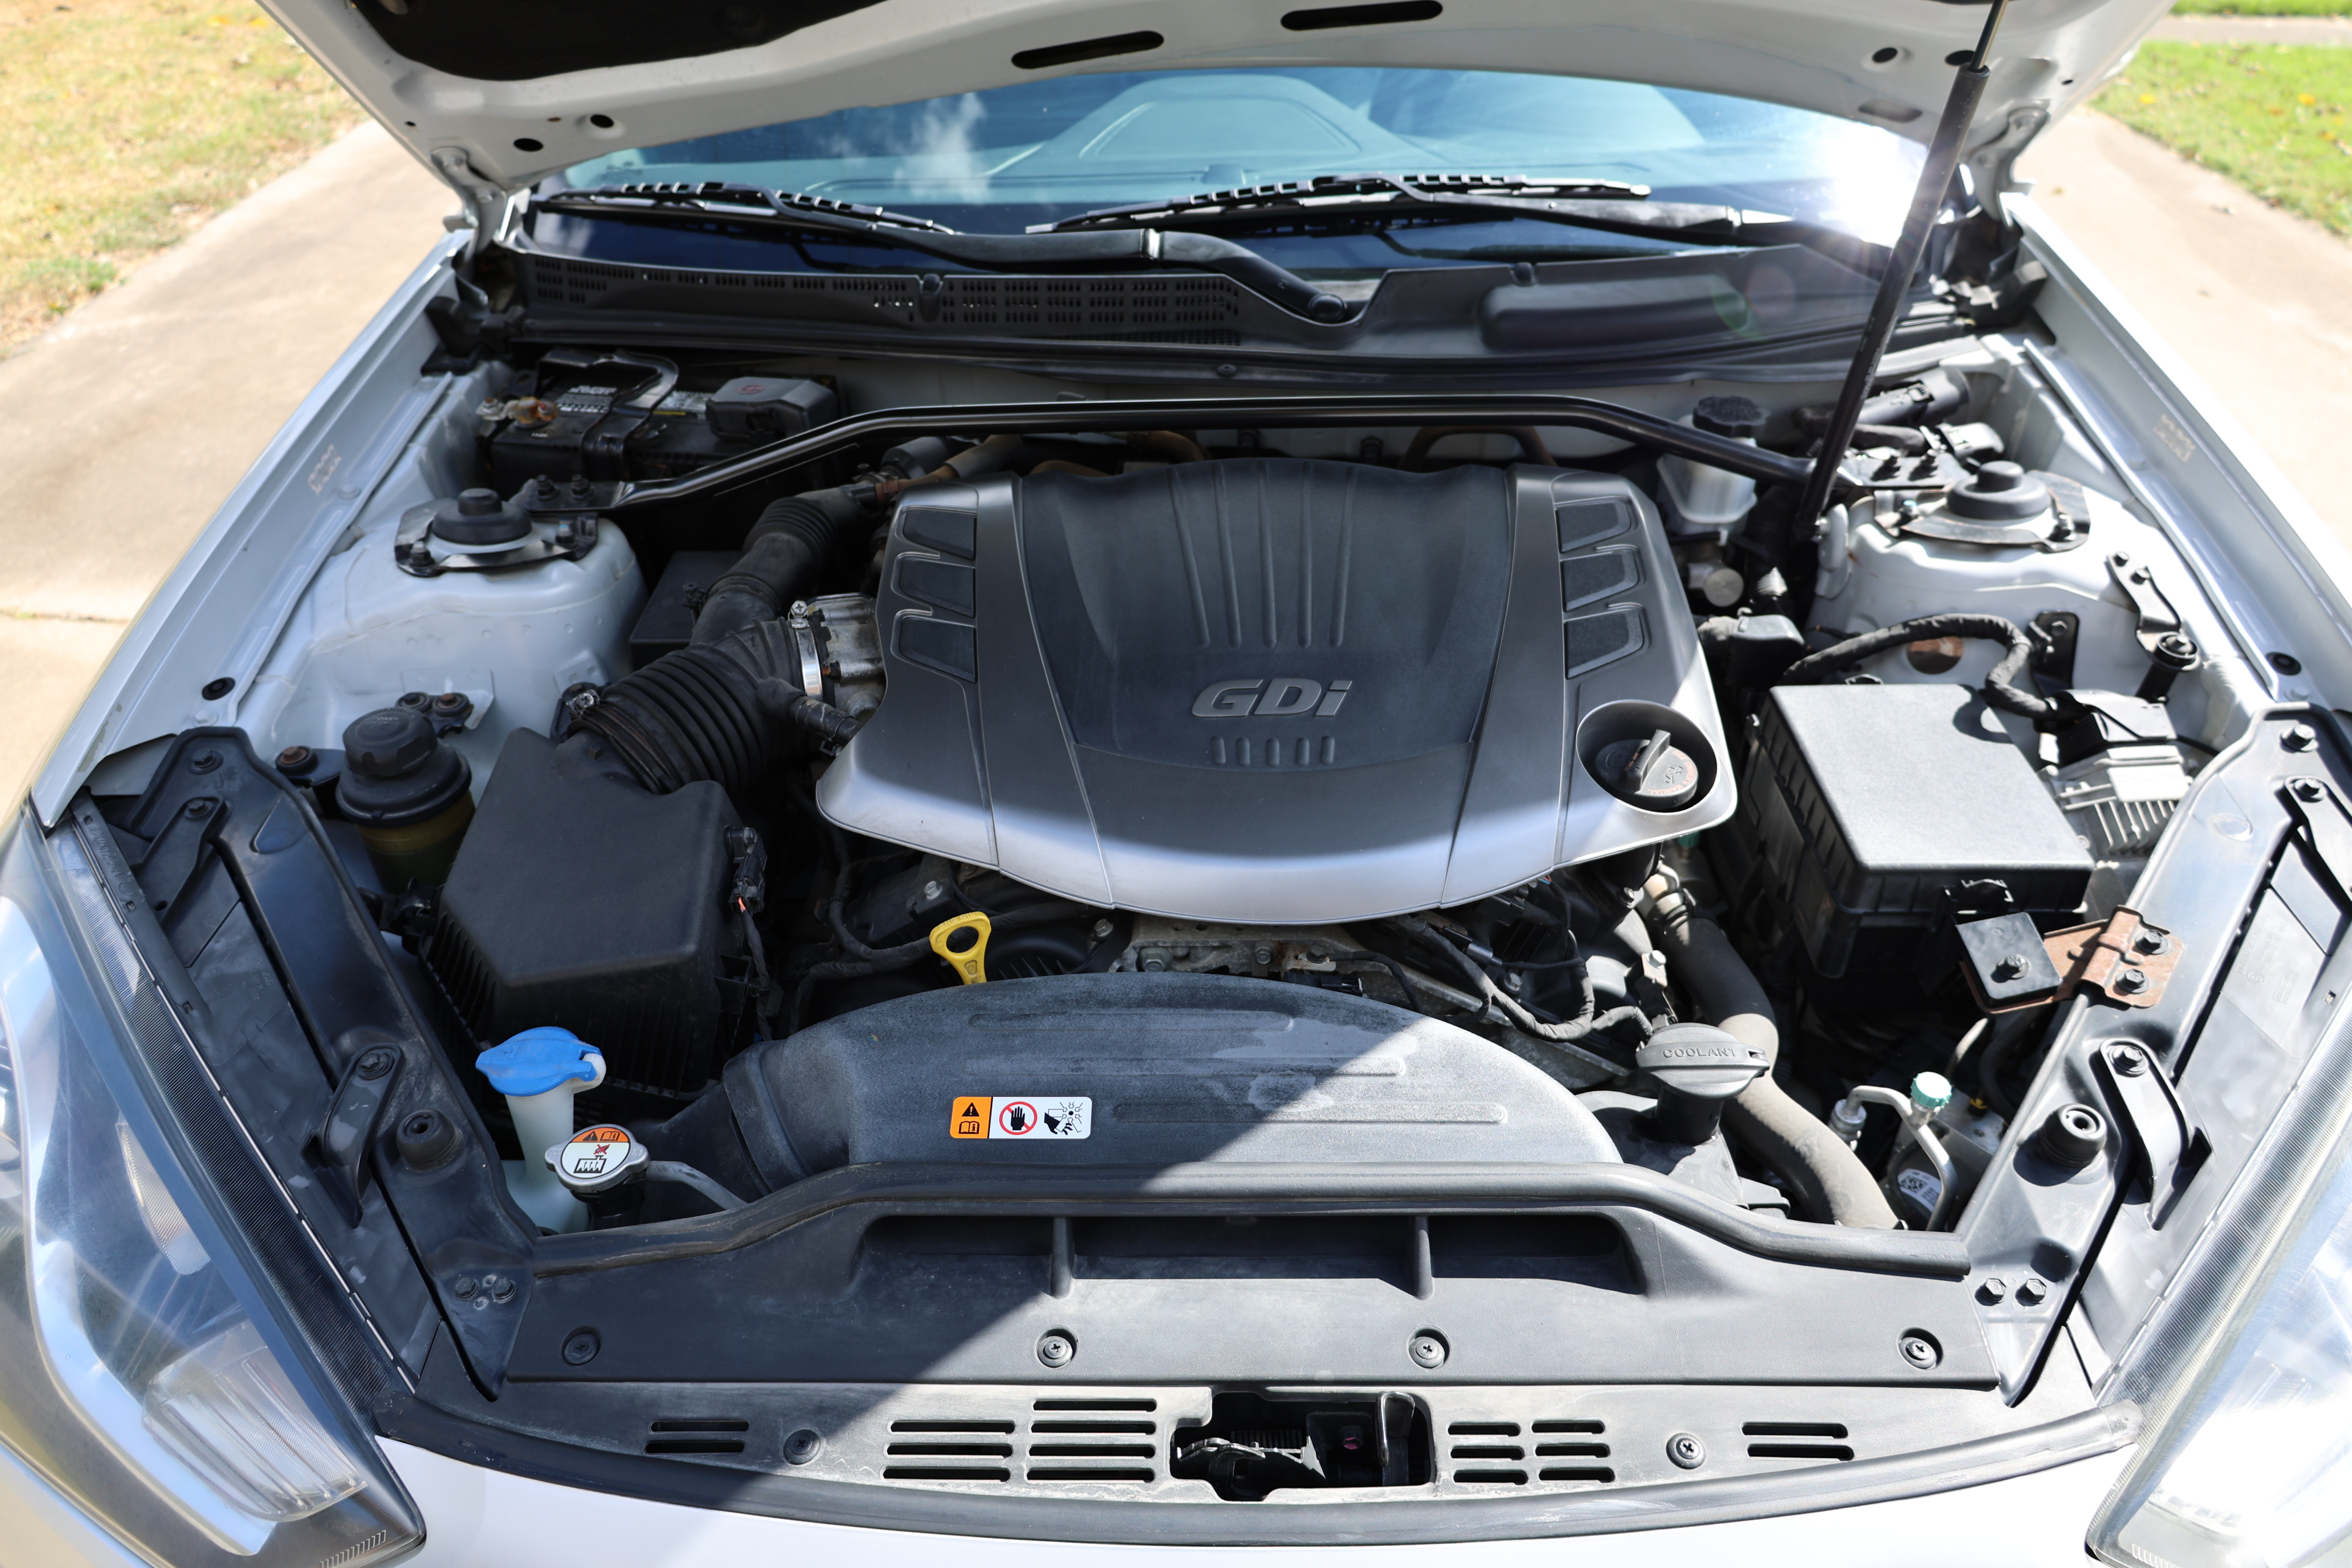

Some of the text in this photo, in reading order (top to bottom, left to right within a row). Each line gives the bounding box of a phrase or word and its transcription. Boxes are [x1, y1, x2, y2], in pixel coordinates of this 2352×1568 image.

[1191, 678, 1352, 717] GDi
[1647, 750, 1695, 794] SEE OWNER'S MANUAL
[938, 917, 958, 929] ENG
[1662, 1047, 1738, 1058] COOLANT
